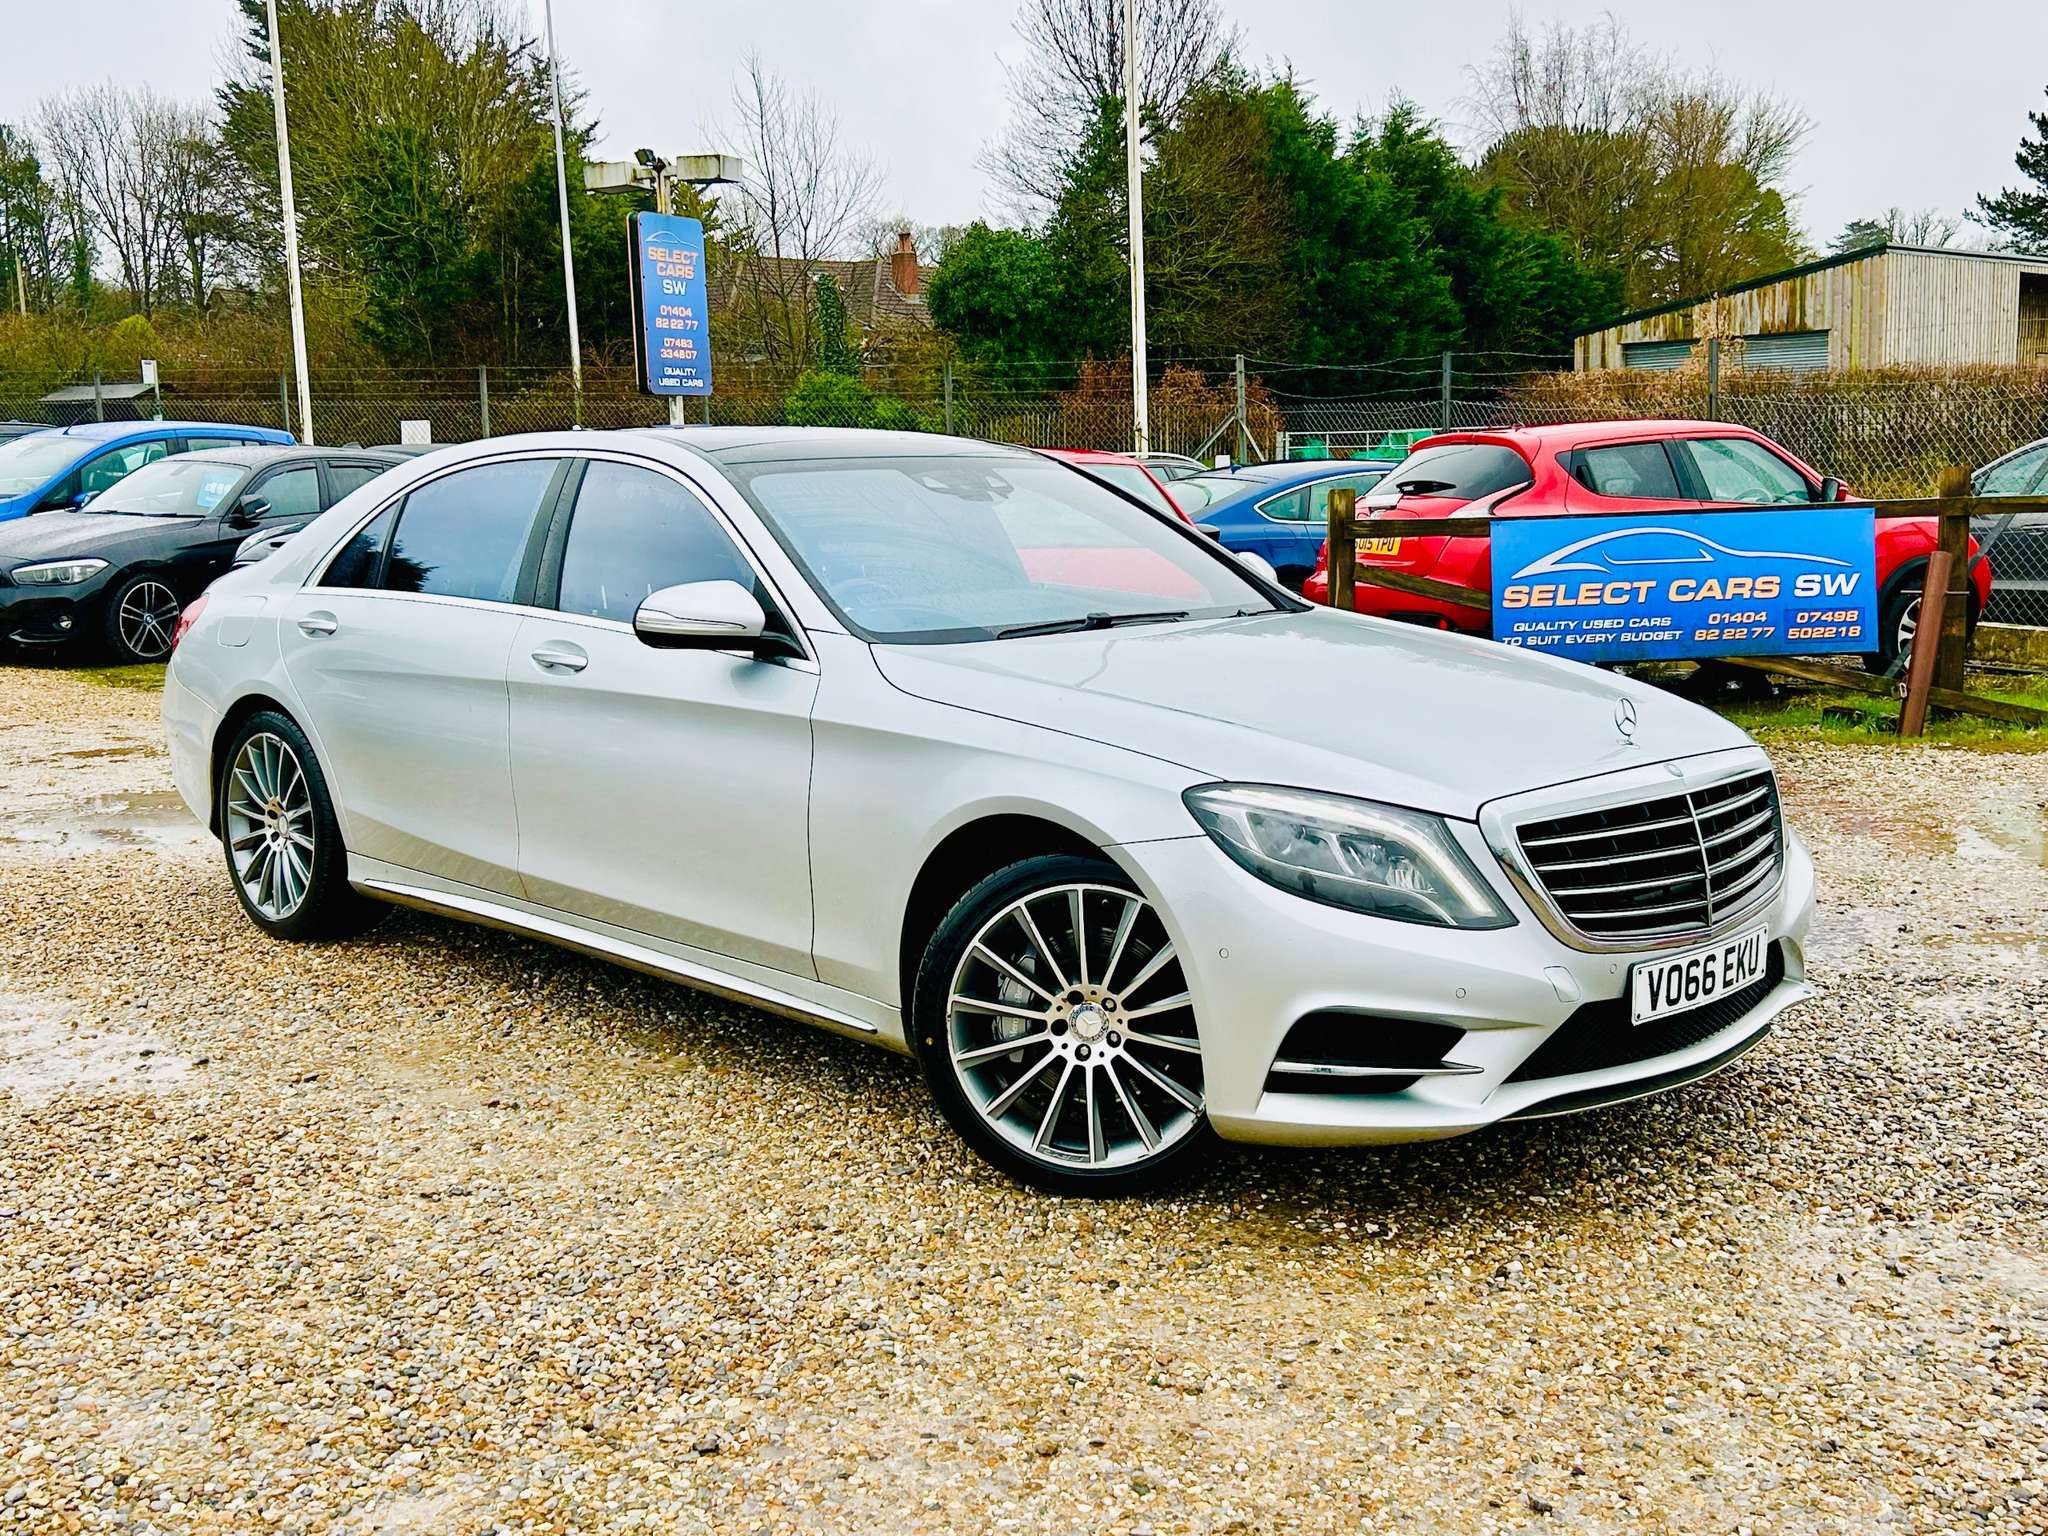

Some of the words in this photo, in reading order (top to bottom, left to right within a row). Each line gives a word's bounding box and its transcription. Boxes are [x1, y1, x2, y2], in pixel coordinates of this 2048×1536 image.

[648, 246, 699, 265] SELECT
[656, 262, 695, 280] CARS
[662, 278, 687, 296] SW
[660, 304, 693, 317] 01404
[663, 367, 696, 377] QUALITY
[658, 378, 680, 387] USED
[682, 379, 704, 388] CARS
[1502, 581, 1657, 609] SELECT
[1668, 576, 1780, 602] CARS
[1794, 573, 1861, 598] SW
[1513, 620, 1579, 632] QUALITY
[1582, 618, 1625, 630] USED
[1629, 617, 1672, 628] CARS
[1708, 611, 1768, 625] 01404
[1796, 610, 1859, 624] 07498
[1502, 637, 1522, 646] TO
[1526, 635, 1561, 646] SUIT
[1565, 633, 1616, 644] EVERY
[1620, 630, 1684, 643] BUDGET
[1787, 626, 1861, 639] 502218
[1647, 953, 1717, 1012] VO66
[1722, 934, 1761, 990] EKU
